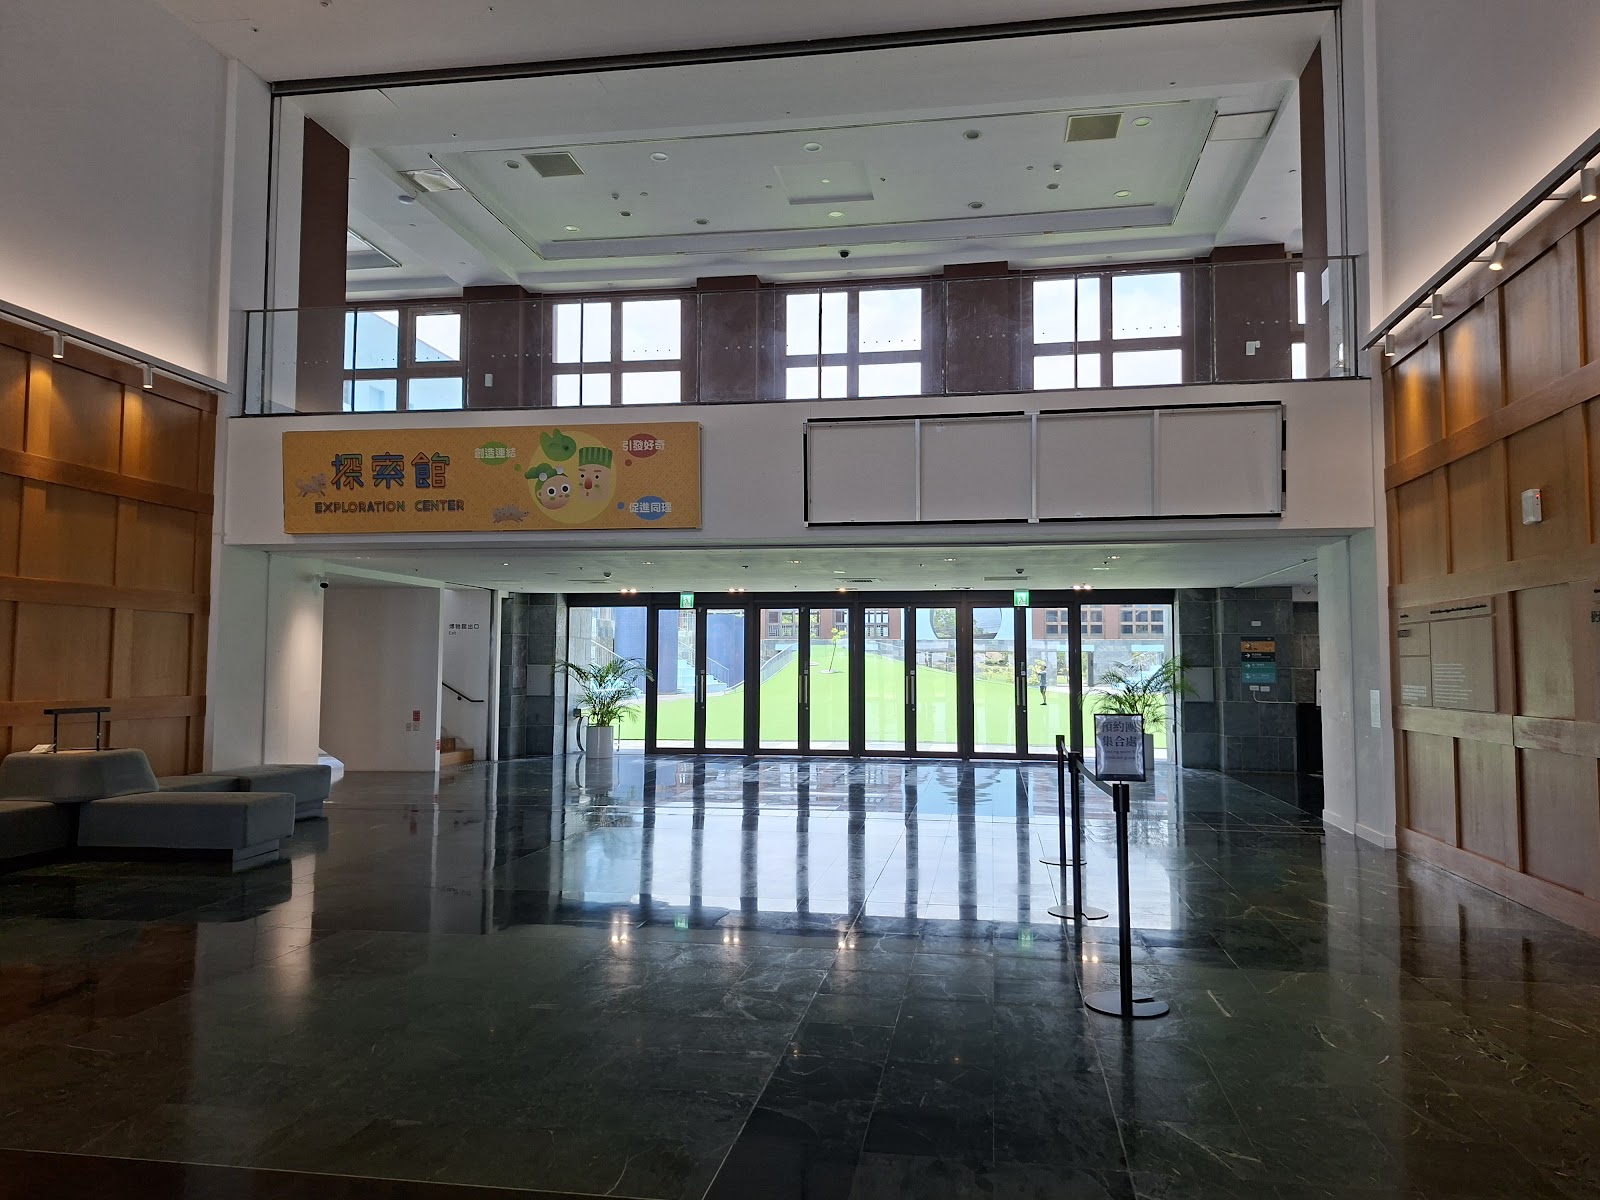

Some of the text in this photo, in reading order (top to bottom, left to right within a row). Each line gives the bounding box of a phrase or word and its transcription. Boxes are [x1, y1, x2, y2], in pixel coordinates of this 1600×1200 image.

[622, 439, 665, 451] 引發好奇
[474, 447, 516, 459] 創造連結
[331, 452, 451, 490] 探索館
[314, 498, 465, 514] EXPLORATION CENTER
[629, 501, 673, 513] 促進同理
